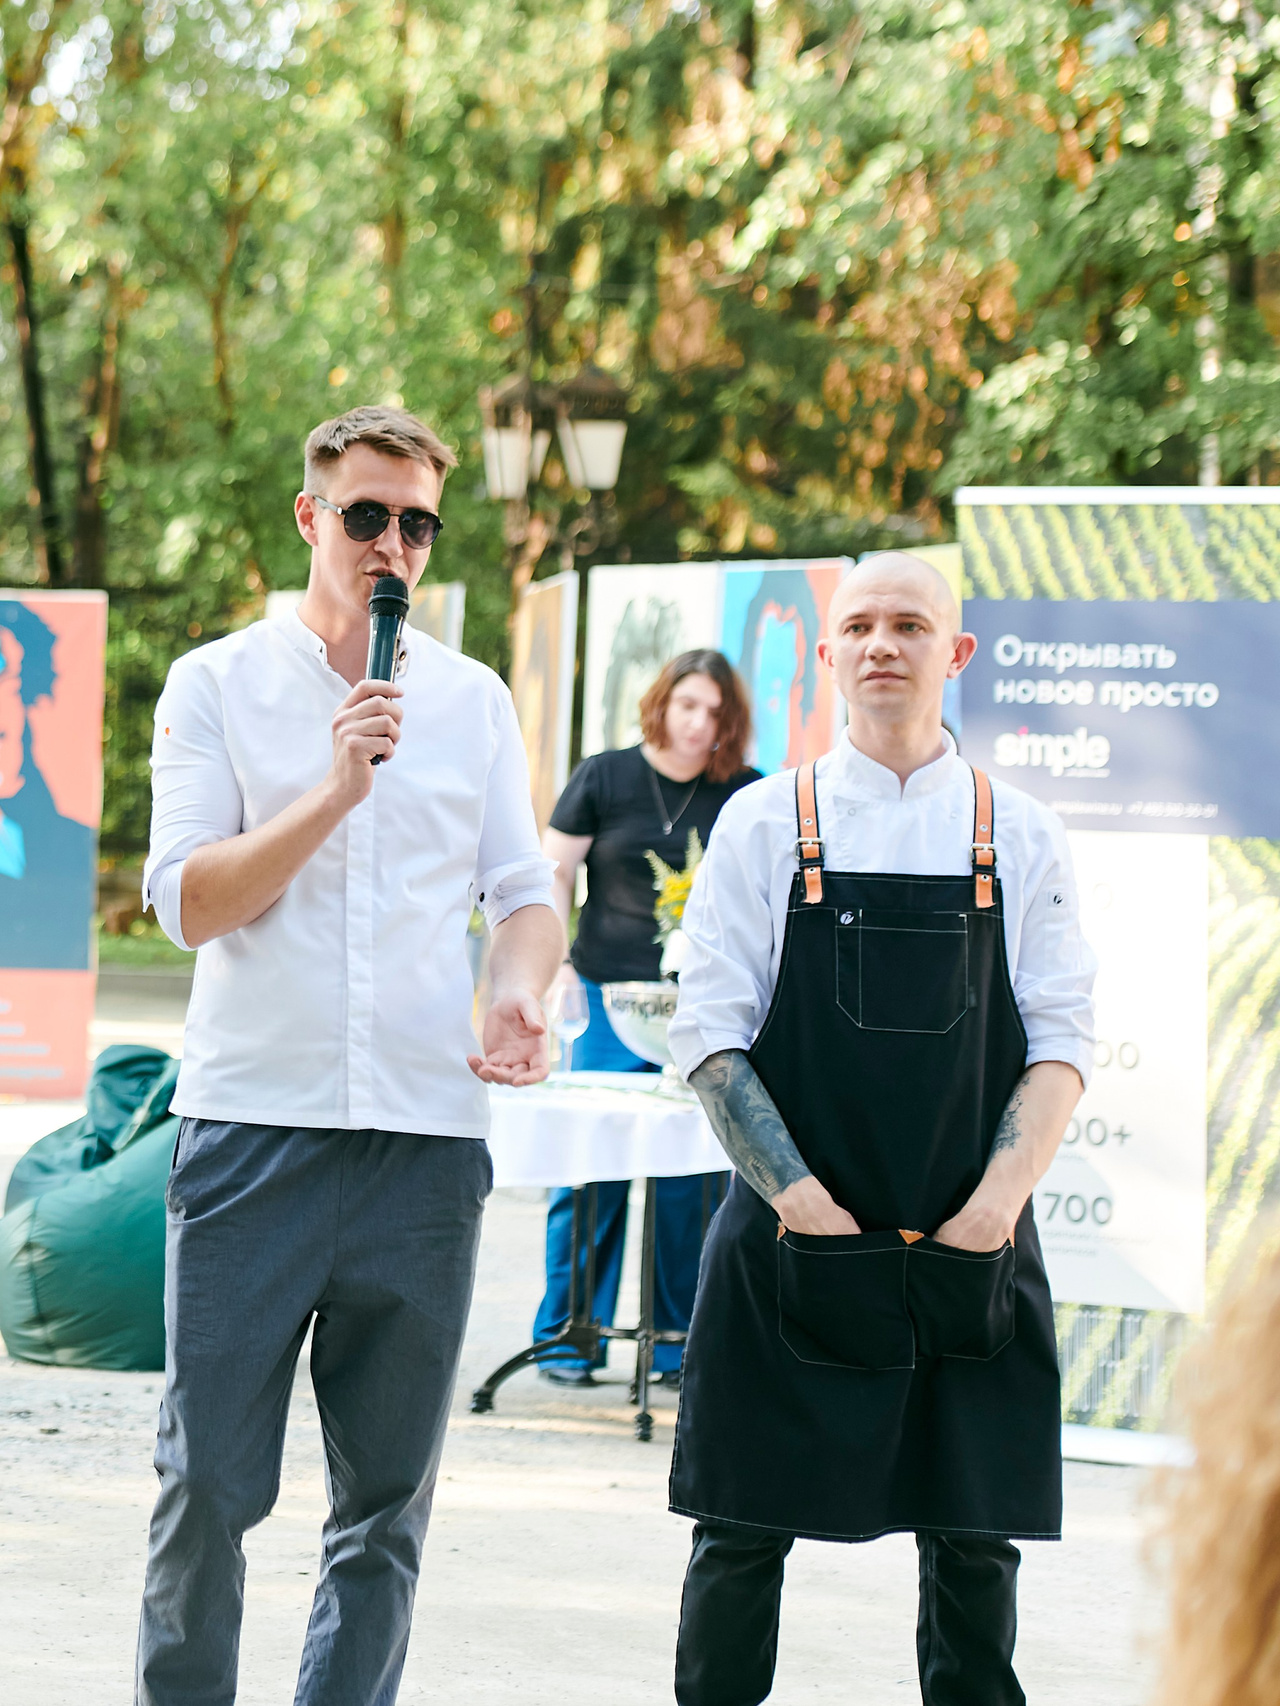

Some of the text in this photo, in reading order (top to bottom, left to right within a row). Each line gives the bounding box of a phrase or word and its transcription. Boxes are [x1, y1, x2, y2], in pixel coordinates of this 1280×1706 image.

[993, 634, 1177, 674] Открывать
[993, 678, 1220, 713] новое просто
[993, 726, 1111, 777] simple
[1042, 1192, 1113, 1225] 700
